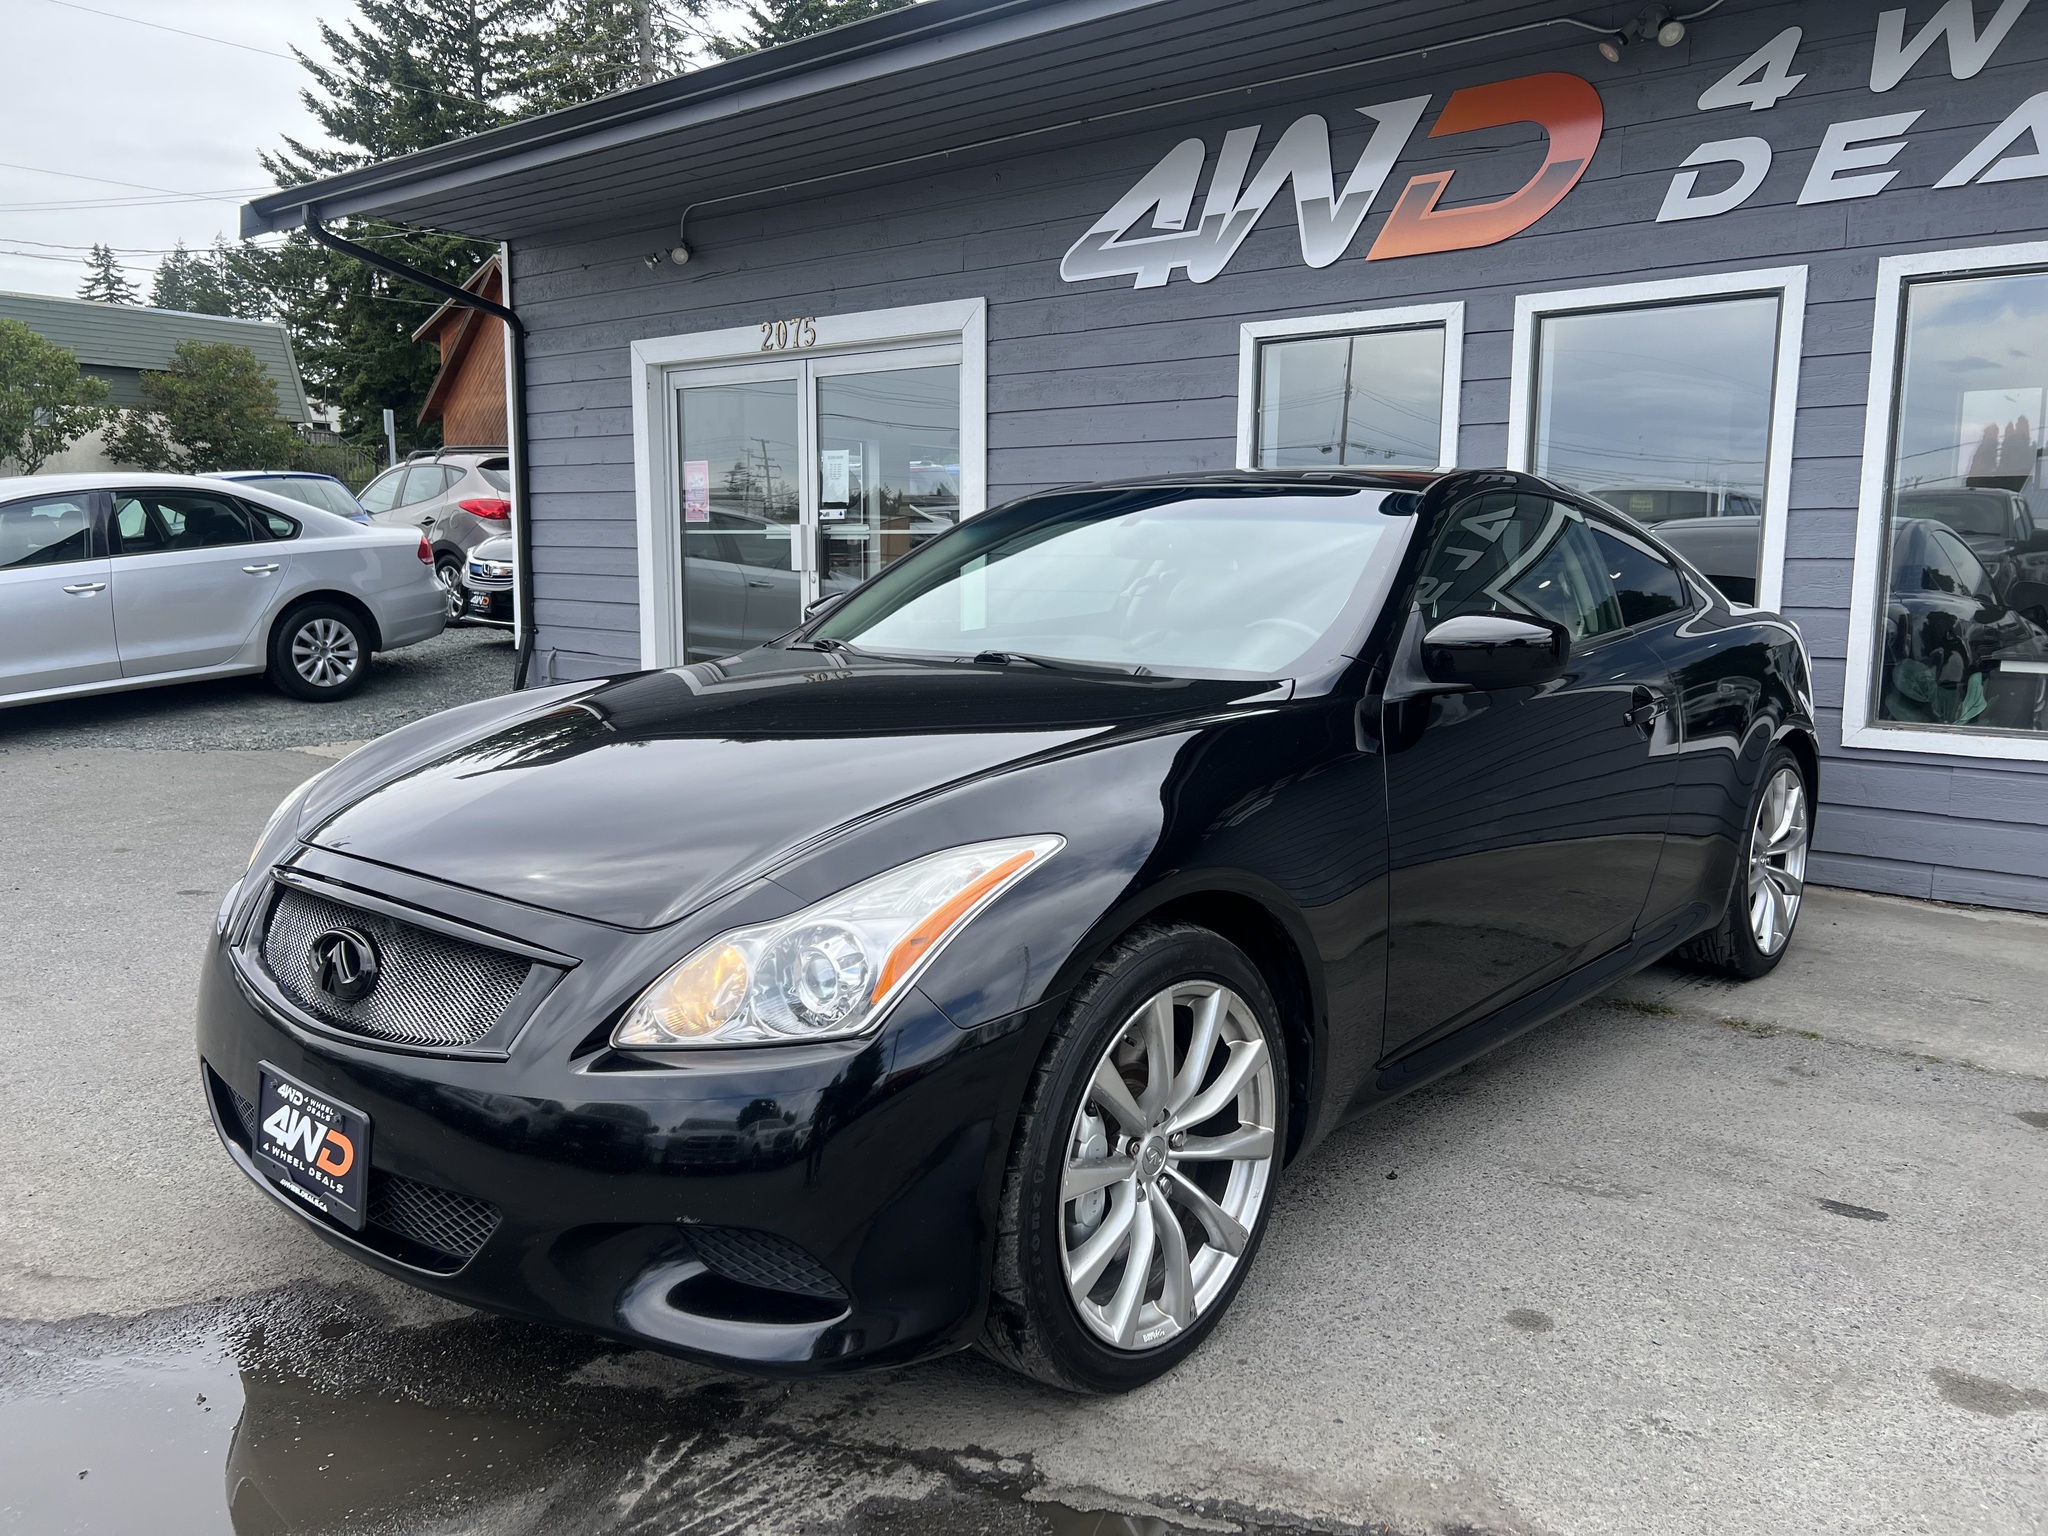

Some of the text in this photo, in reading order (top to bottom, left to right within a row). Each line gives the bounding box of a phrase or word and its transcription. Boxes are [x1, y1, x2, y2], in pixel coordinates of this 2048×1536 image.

[1697, 26, 1808, 111] 4
[1060, 71, 1605, 290] 4WD
[761, 316, 817, 351] 2075
[277, 1083, 303, 1106] 4WD
[310, 1098, 334, 1116] WHEEL
[306, 1105, 332, 1122] DEALS
[263, 1105, 354, 1177] 4WD
[263, 1142, 344, 1194] 4 WHEEL DEALS
